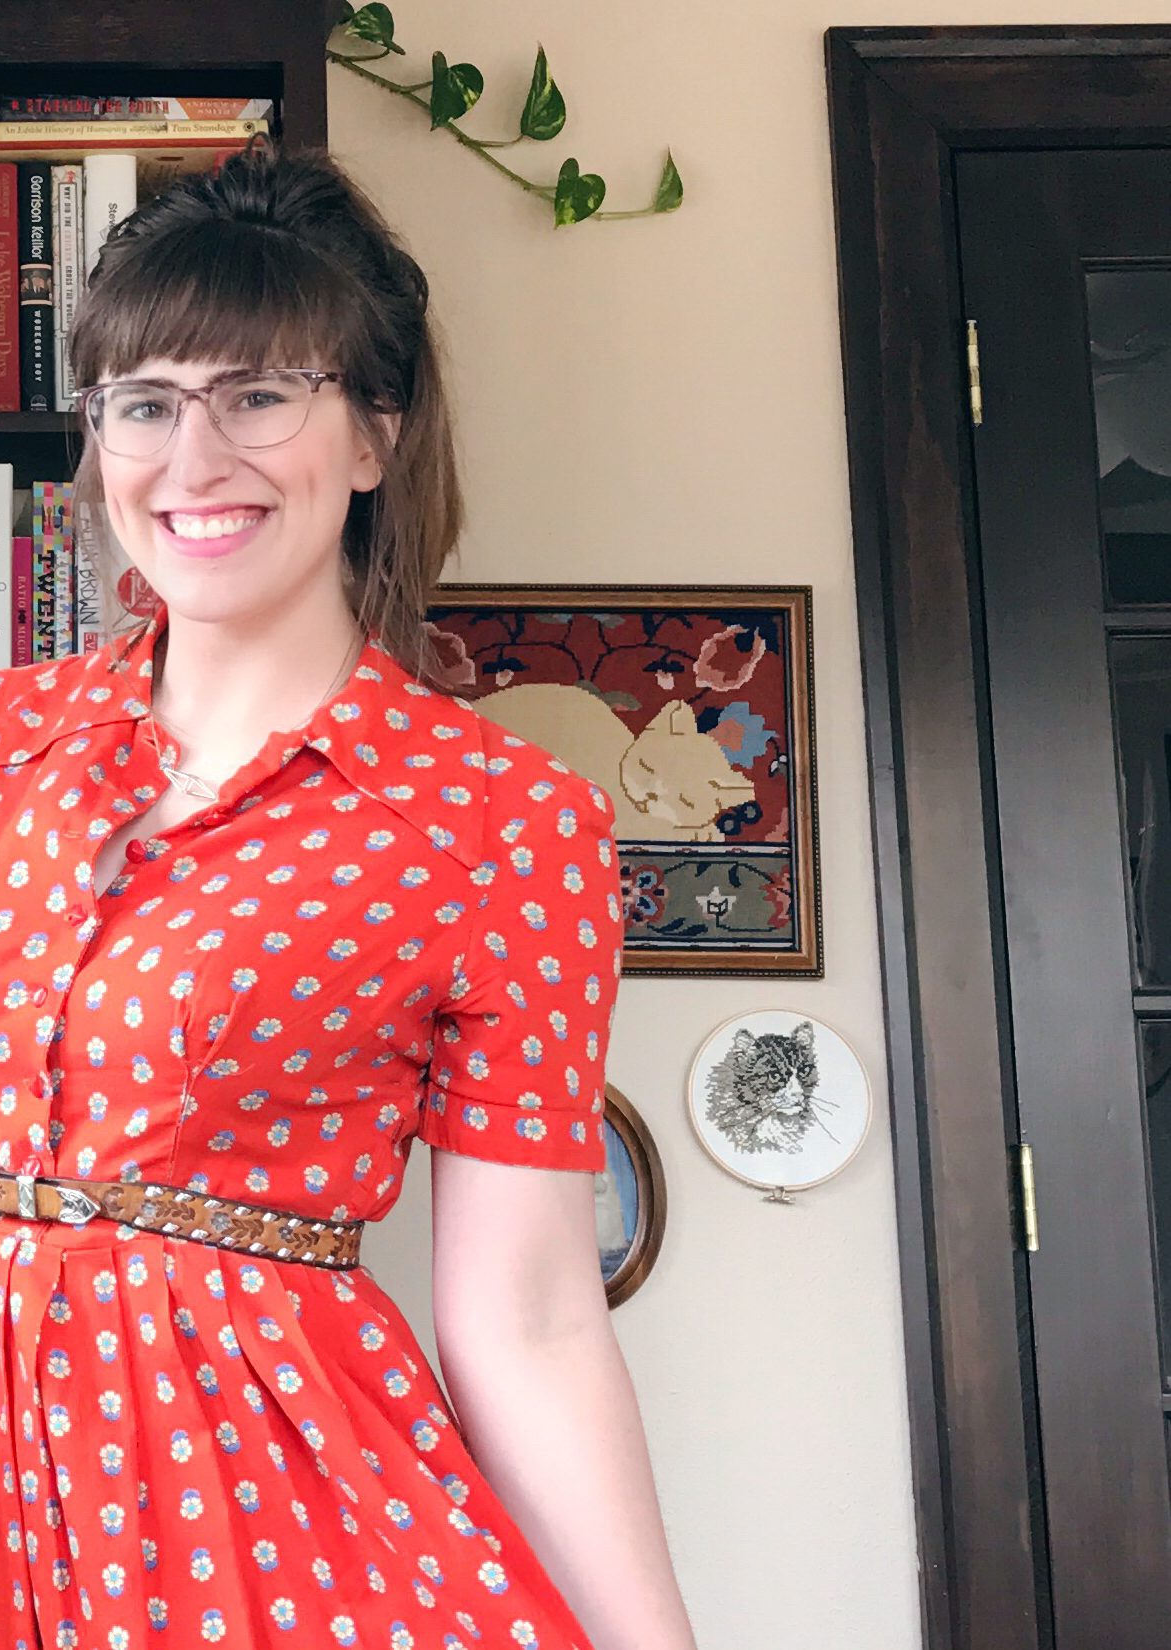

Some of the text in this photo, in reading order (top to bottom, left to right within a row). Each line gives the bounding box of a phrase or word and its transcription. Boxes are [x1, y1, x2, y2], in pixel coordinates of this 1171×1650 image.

[171, 123, 236, 134] Tom Standage
[30, 175, 45, 260] Garrison Keillor
[65, 265, 73, 286] CROSS
[34, 309, 42, 382] WOBEGON BOY
[17, 575, 27, 666] RATIO MICHA
[37, 550, 55, 660] TWENT
[78, 569, 101, 625] BROWN
